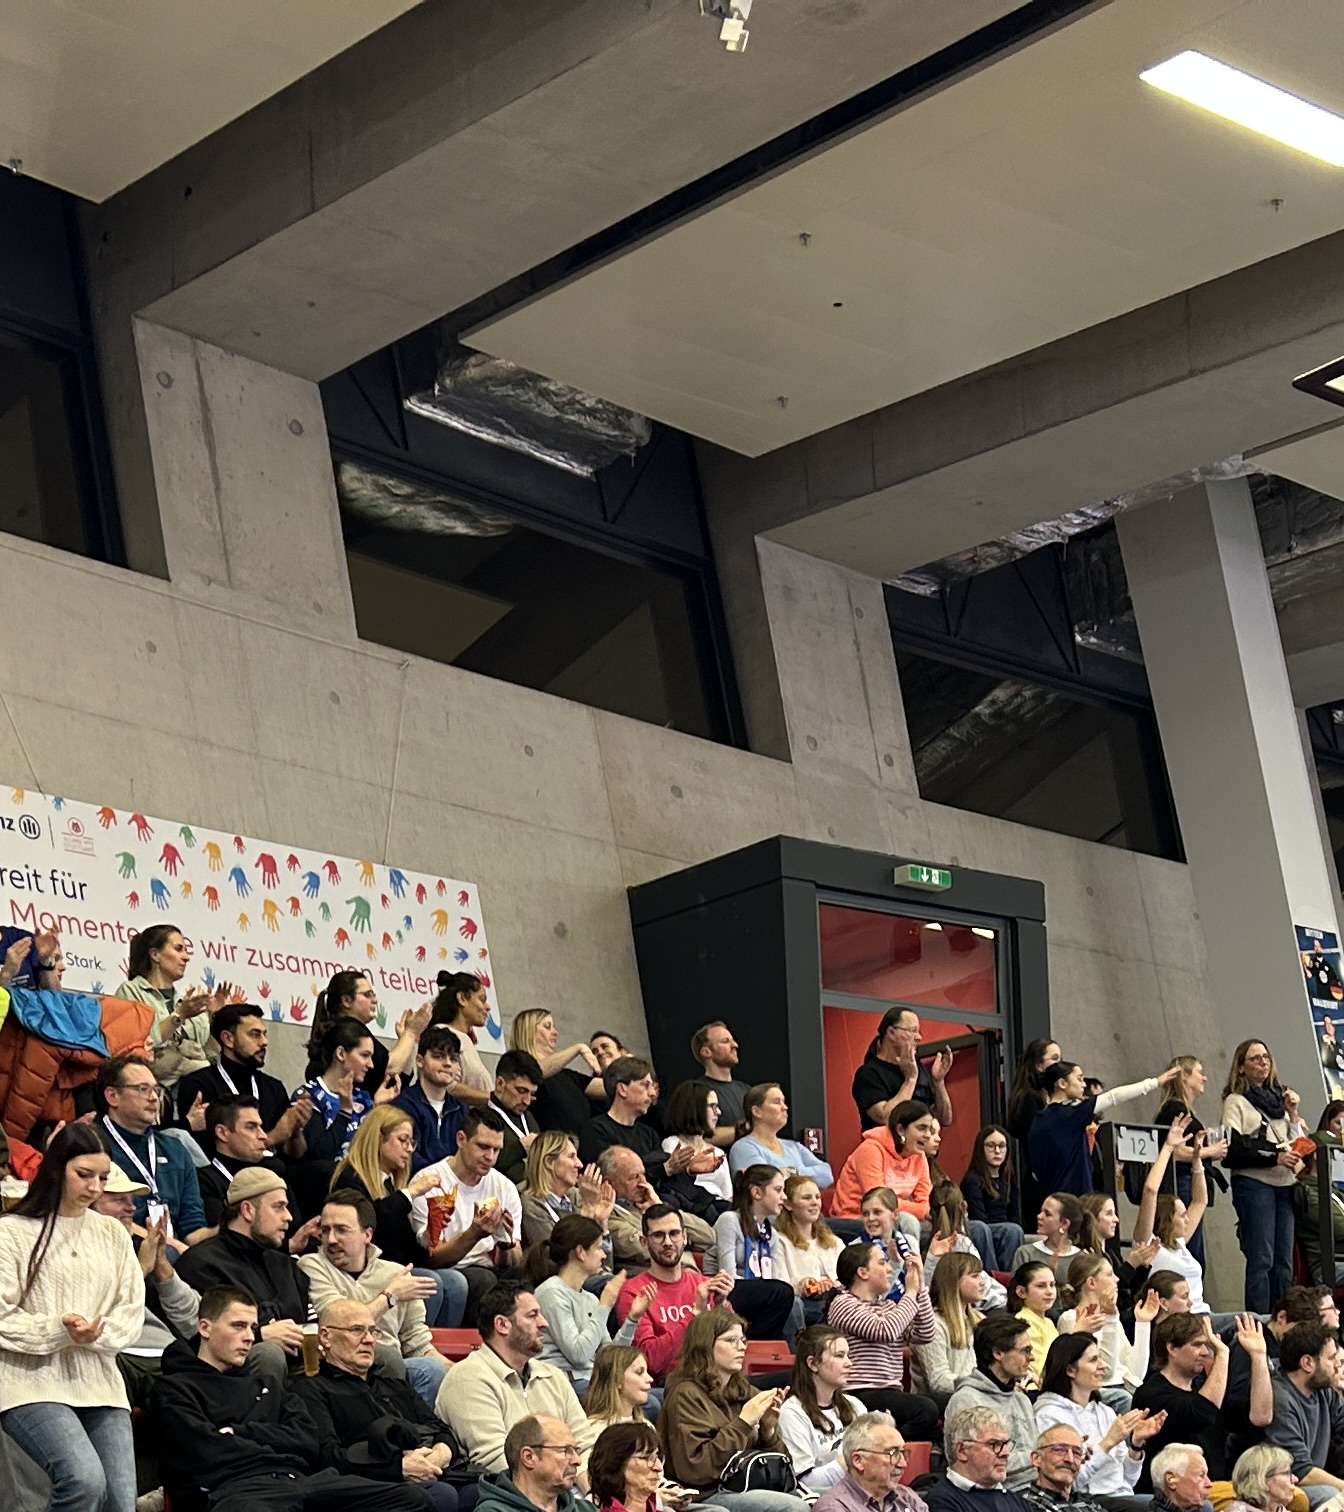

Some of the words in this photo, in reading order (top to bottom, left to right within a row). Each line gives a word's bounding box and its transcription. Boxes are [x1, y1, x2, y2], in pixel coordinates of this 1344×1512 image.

[50, 869, 88, 901] für
[200, 936, 238, 962] wir
[1130, 1137, 1147, 1156] 12
